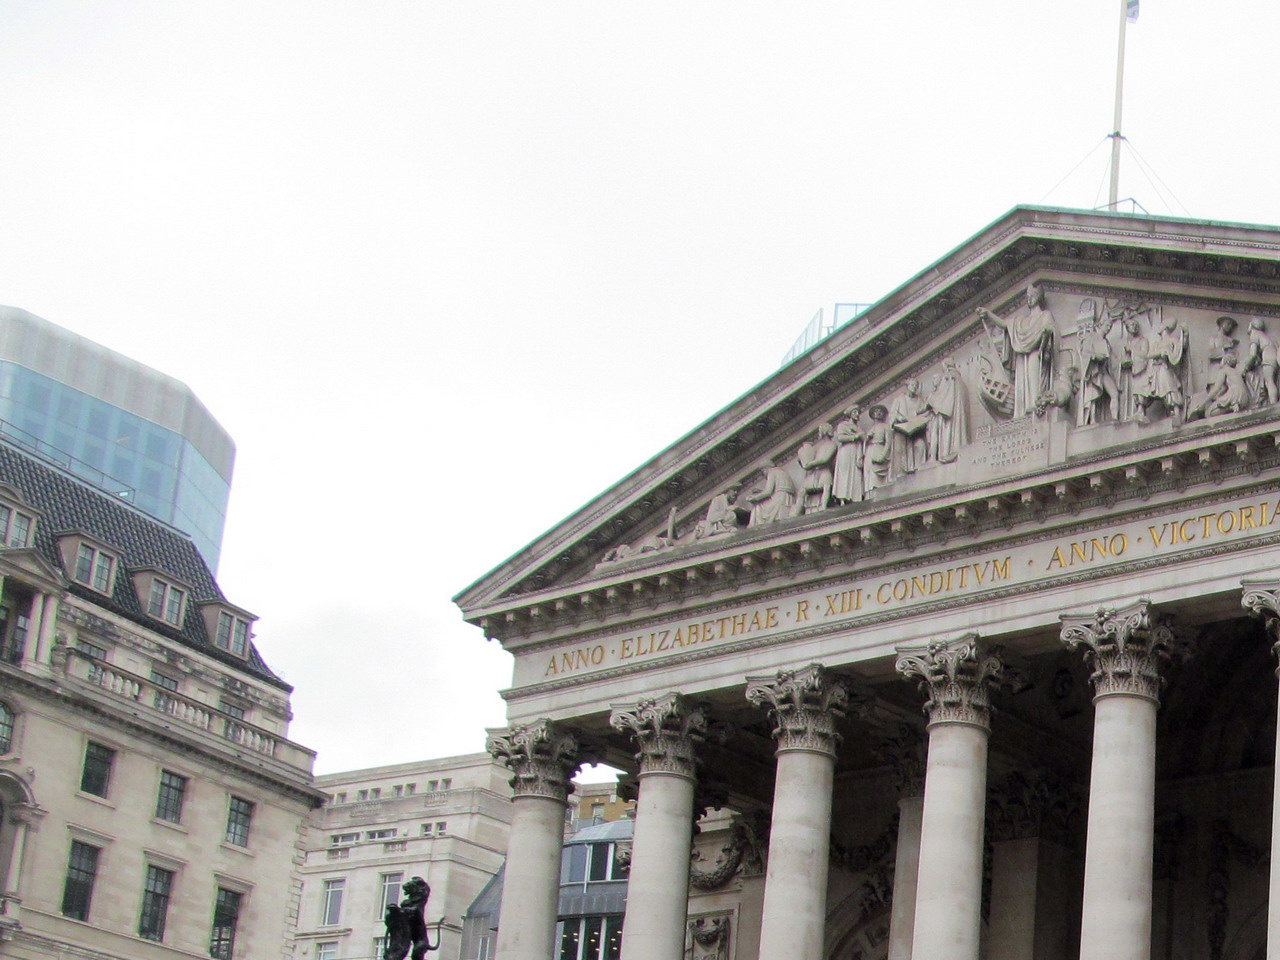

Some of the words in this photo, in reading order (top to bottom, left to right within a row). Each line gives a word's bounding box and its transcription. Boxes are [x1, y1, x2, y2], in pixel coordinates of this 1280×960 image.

[544, 645, 606, 676] ANNO
[619, 606, 780, 660] ELIZABETHAE
[796, 600, 810, 622] R
[824, 588, 864, 617] XIII
[876, 556, 1012, 604] CONDITVM
[1046, 533, 1129, 571] ANNO
